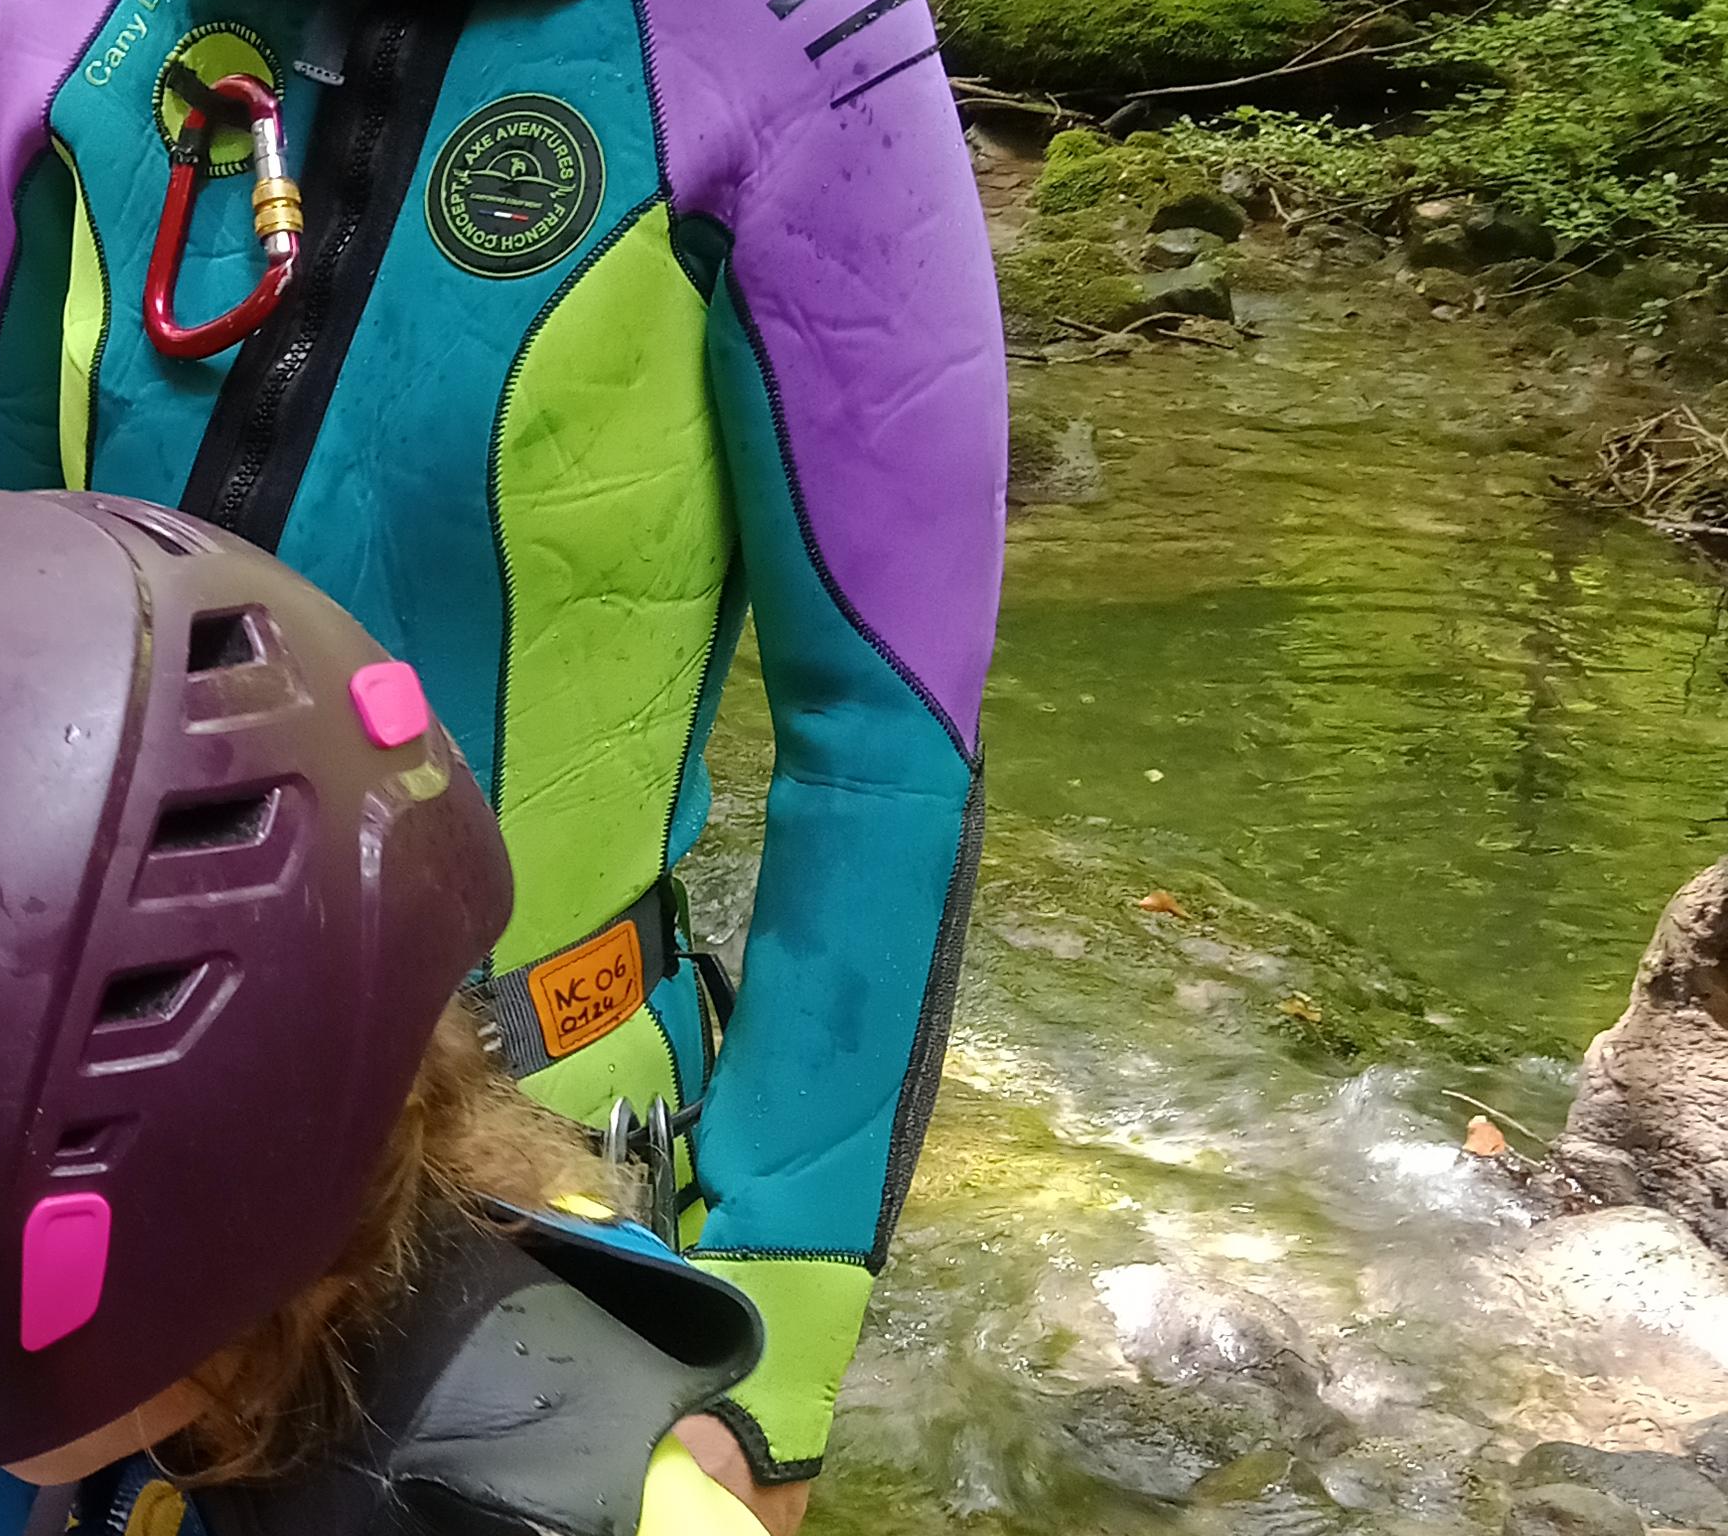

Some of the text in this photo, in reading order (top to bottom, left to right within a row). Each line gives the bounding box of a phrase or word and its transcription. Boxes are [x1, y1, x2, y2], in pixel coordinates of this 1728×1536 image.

[85, 13, 148, 86] Cany
[465, 122, 574, 180] AXE AVENTURES
[450, 182, 565, 250] FRENCH CONCEPT
[595, 954, 626, 991] 06
